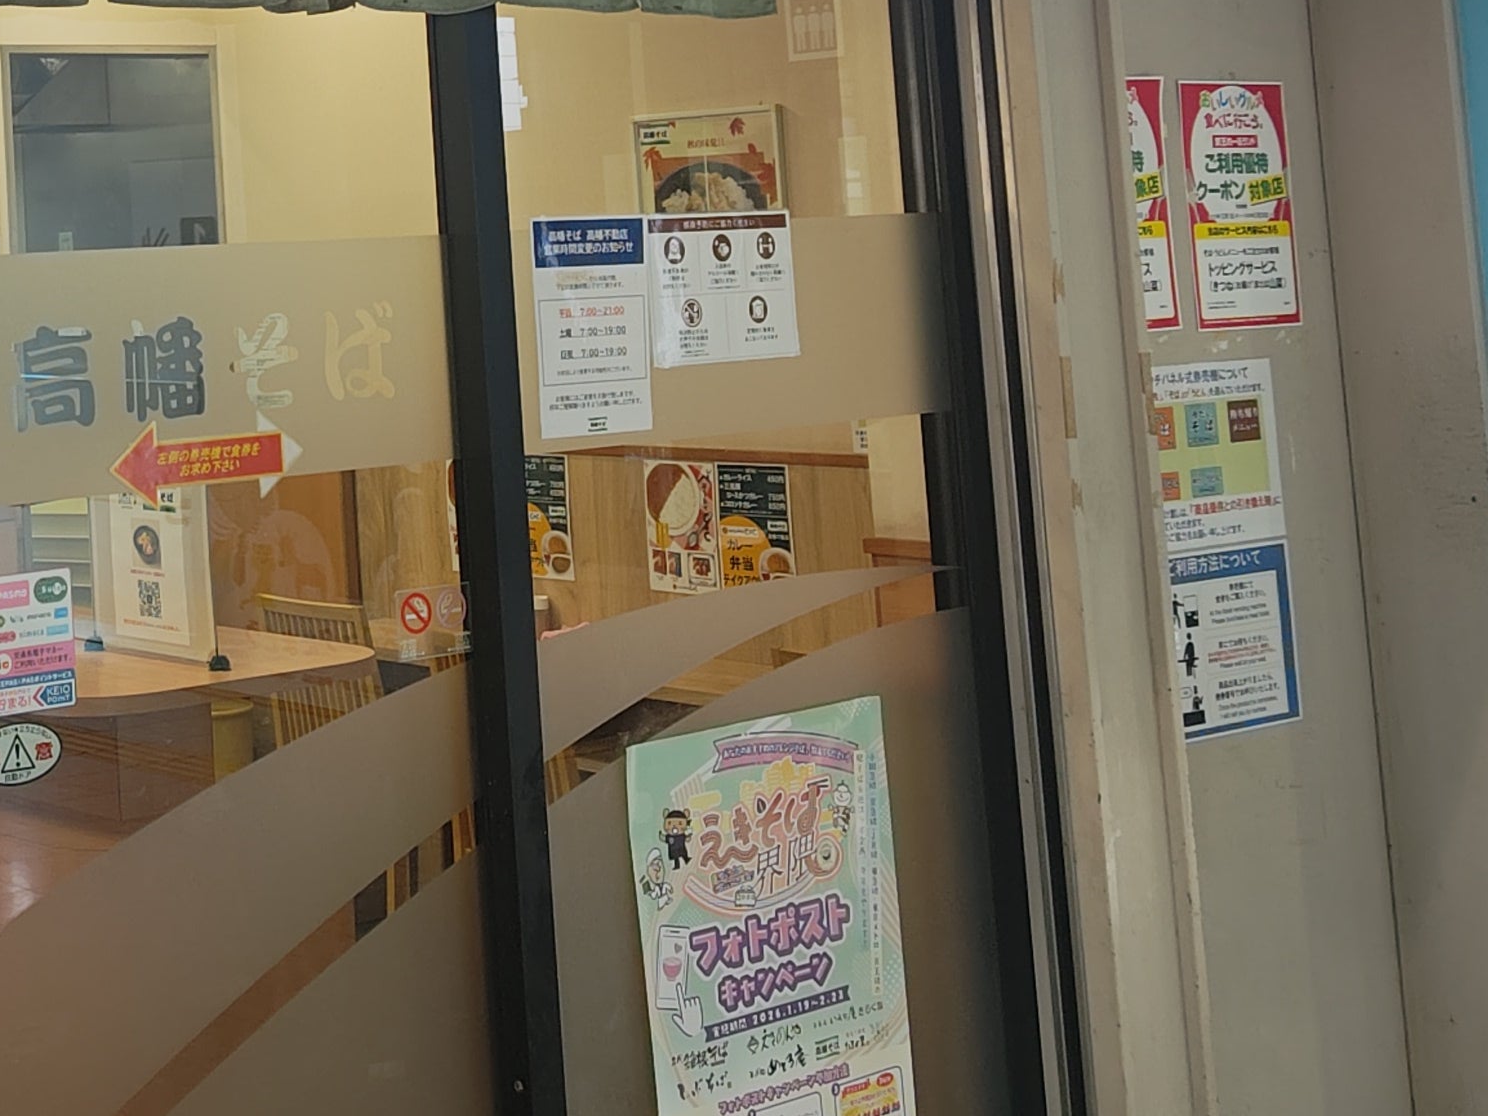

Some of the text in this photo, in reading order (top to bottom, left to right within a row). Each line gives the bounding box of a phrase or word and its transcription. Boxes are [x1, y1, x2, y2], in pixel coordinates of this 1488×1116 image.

[1197, 179, 1246, 201] クーポン
[1248, 176, 1285, 202] 対象店
[12, 301, 397, 433] 高幡そば
[727, 539, 753, 550] カレー
[729, 556, 755, 572] 弁当
[46, 684, 71, 696] KEIO
[690, 893, 851, 975] フォトポスト
[718, 952, 833, 1012] キャンペーン
